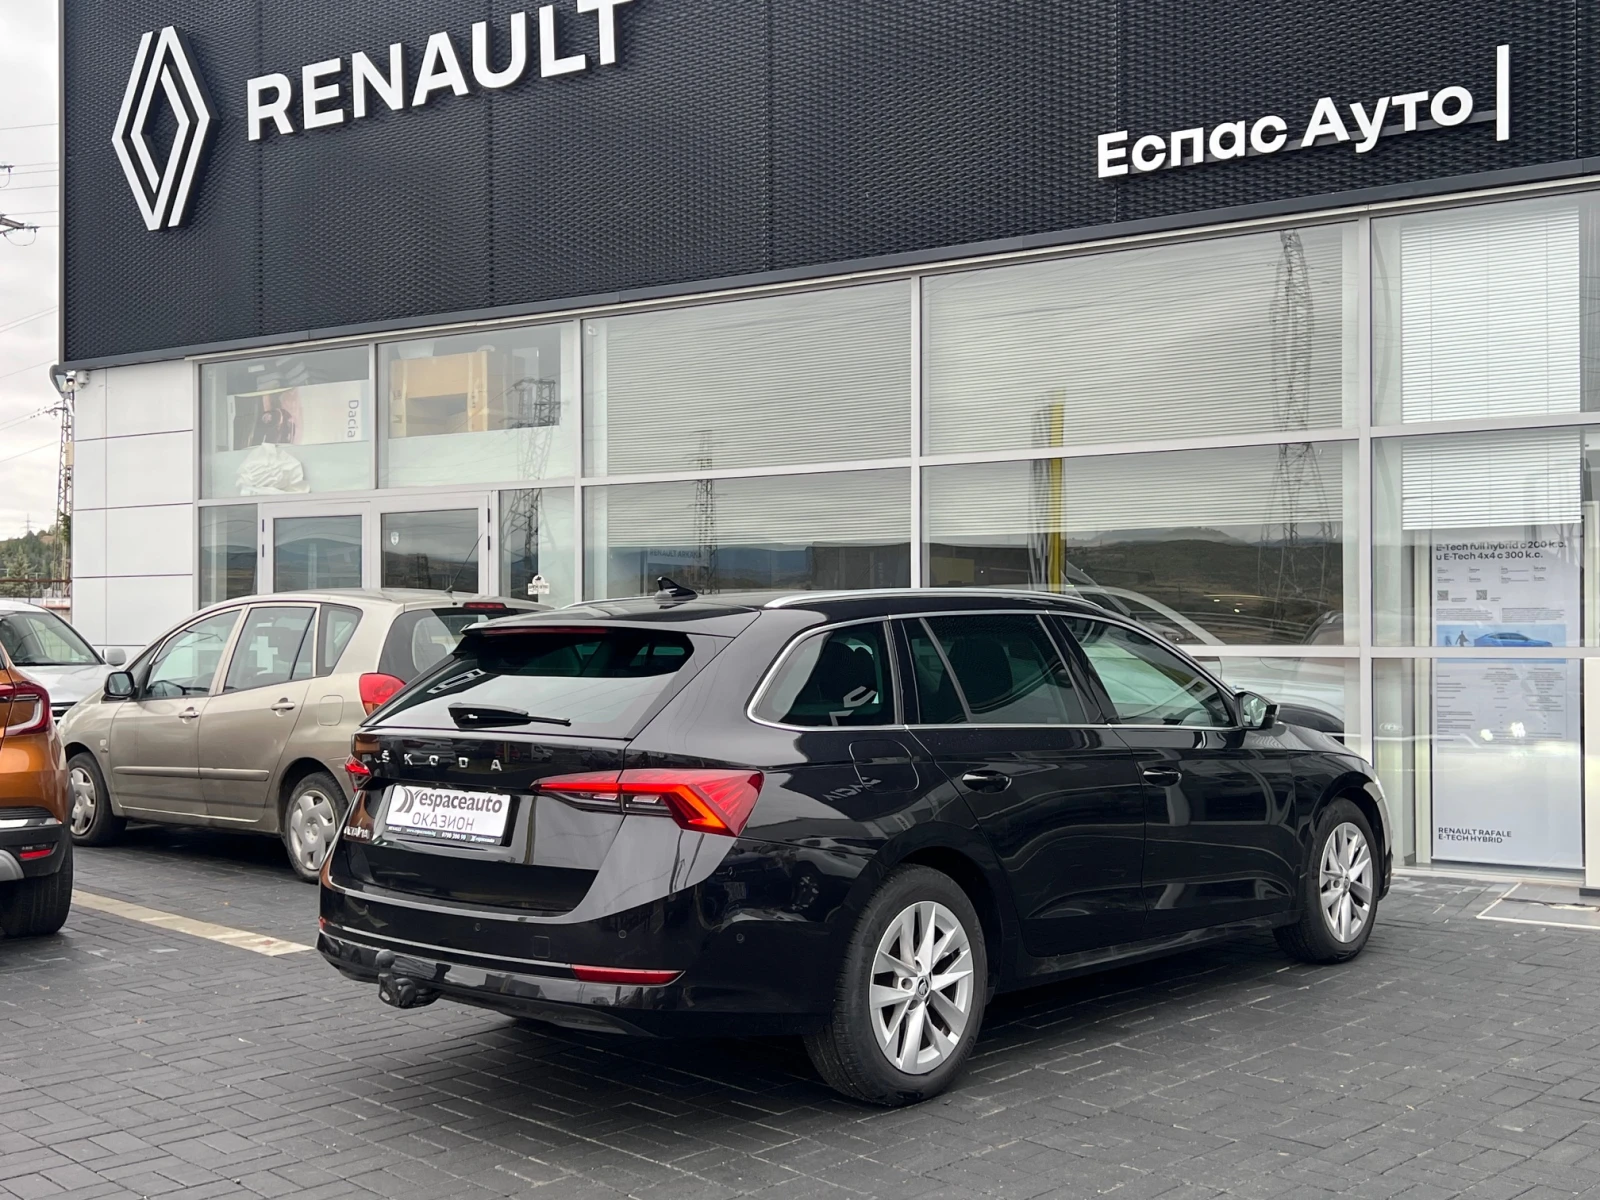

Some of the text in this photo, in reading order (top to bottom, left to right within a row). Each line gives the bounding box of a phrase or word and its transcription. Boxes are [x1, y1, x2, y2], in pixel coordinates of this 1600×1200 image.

[247, 0, 635, 141] RENAULT
[1097, 85, 1473, 178] Еспас Ауто
[346, 399, 359, 438] Dacia
[1443, 552, 1476, 561] E-Tech
[1505, 551, 1524, 559] 300
[419, 791, 503, 814] espaceauto
[412, 812, 475, 831] ОКАЗИОН
[1438, 827, 1512, 838] RENAULT RAFALE
[1438, 833, 1503, 844] E-TECH HYBRID
